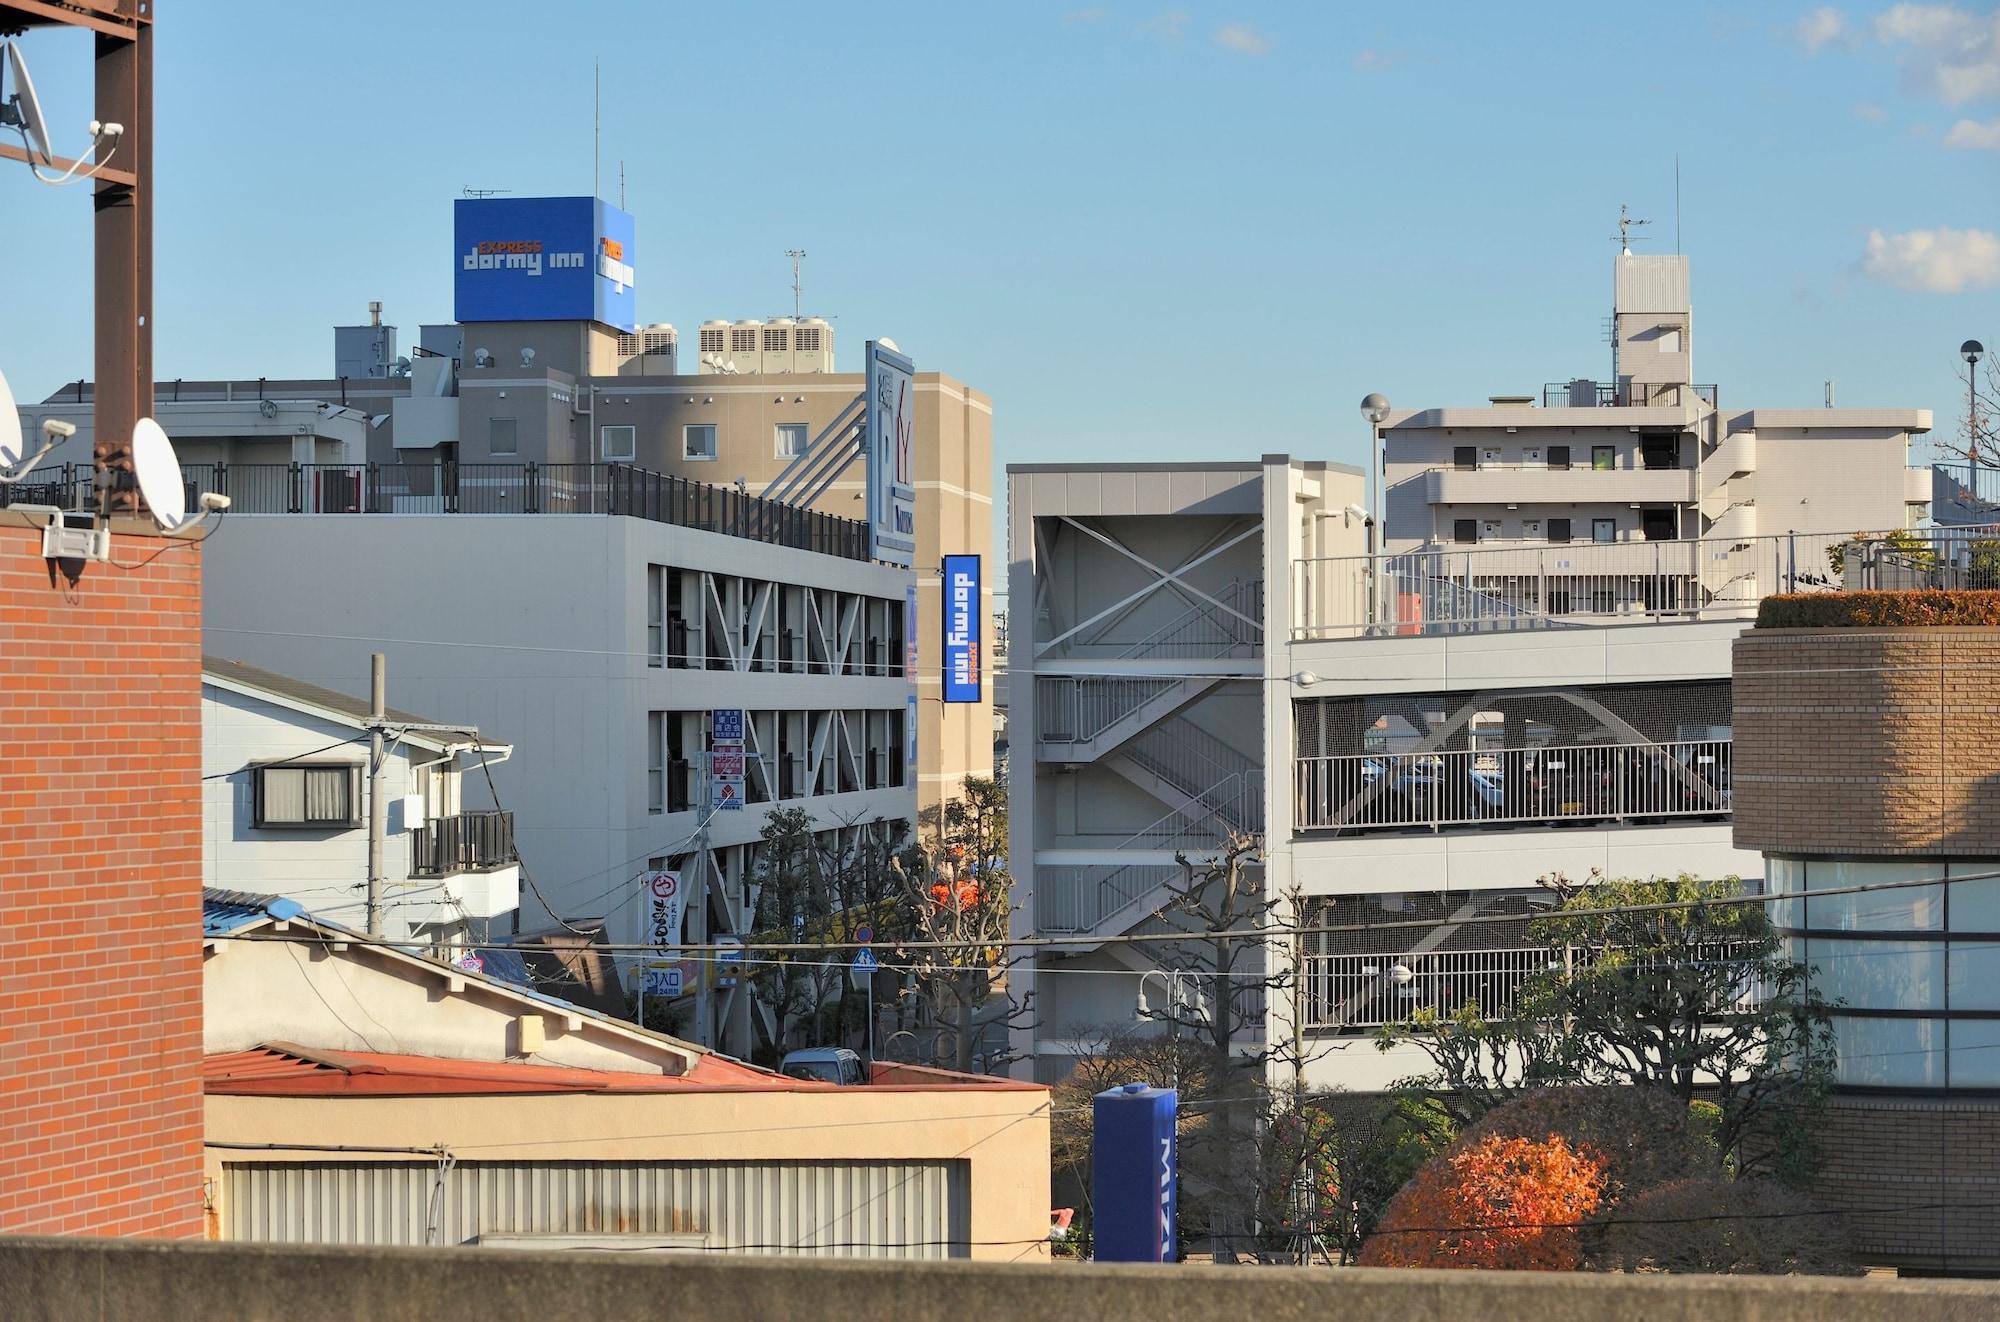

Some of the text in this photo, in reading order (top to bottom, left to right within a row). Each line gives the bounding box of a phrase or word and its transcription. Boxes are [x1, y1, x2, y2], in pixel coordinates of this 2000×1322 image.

[463, 247, 584, 276] dormy inn
[479, 240, 542, 254] EXPRESS
[947, 572, 976, 685] dormy inn
[968, 641, 978, 685] EXPRESS
[659, 972, 679, 986] 入口
